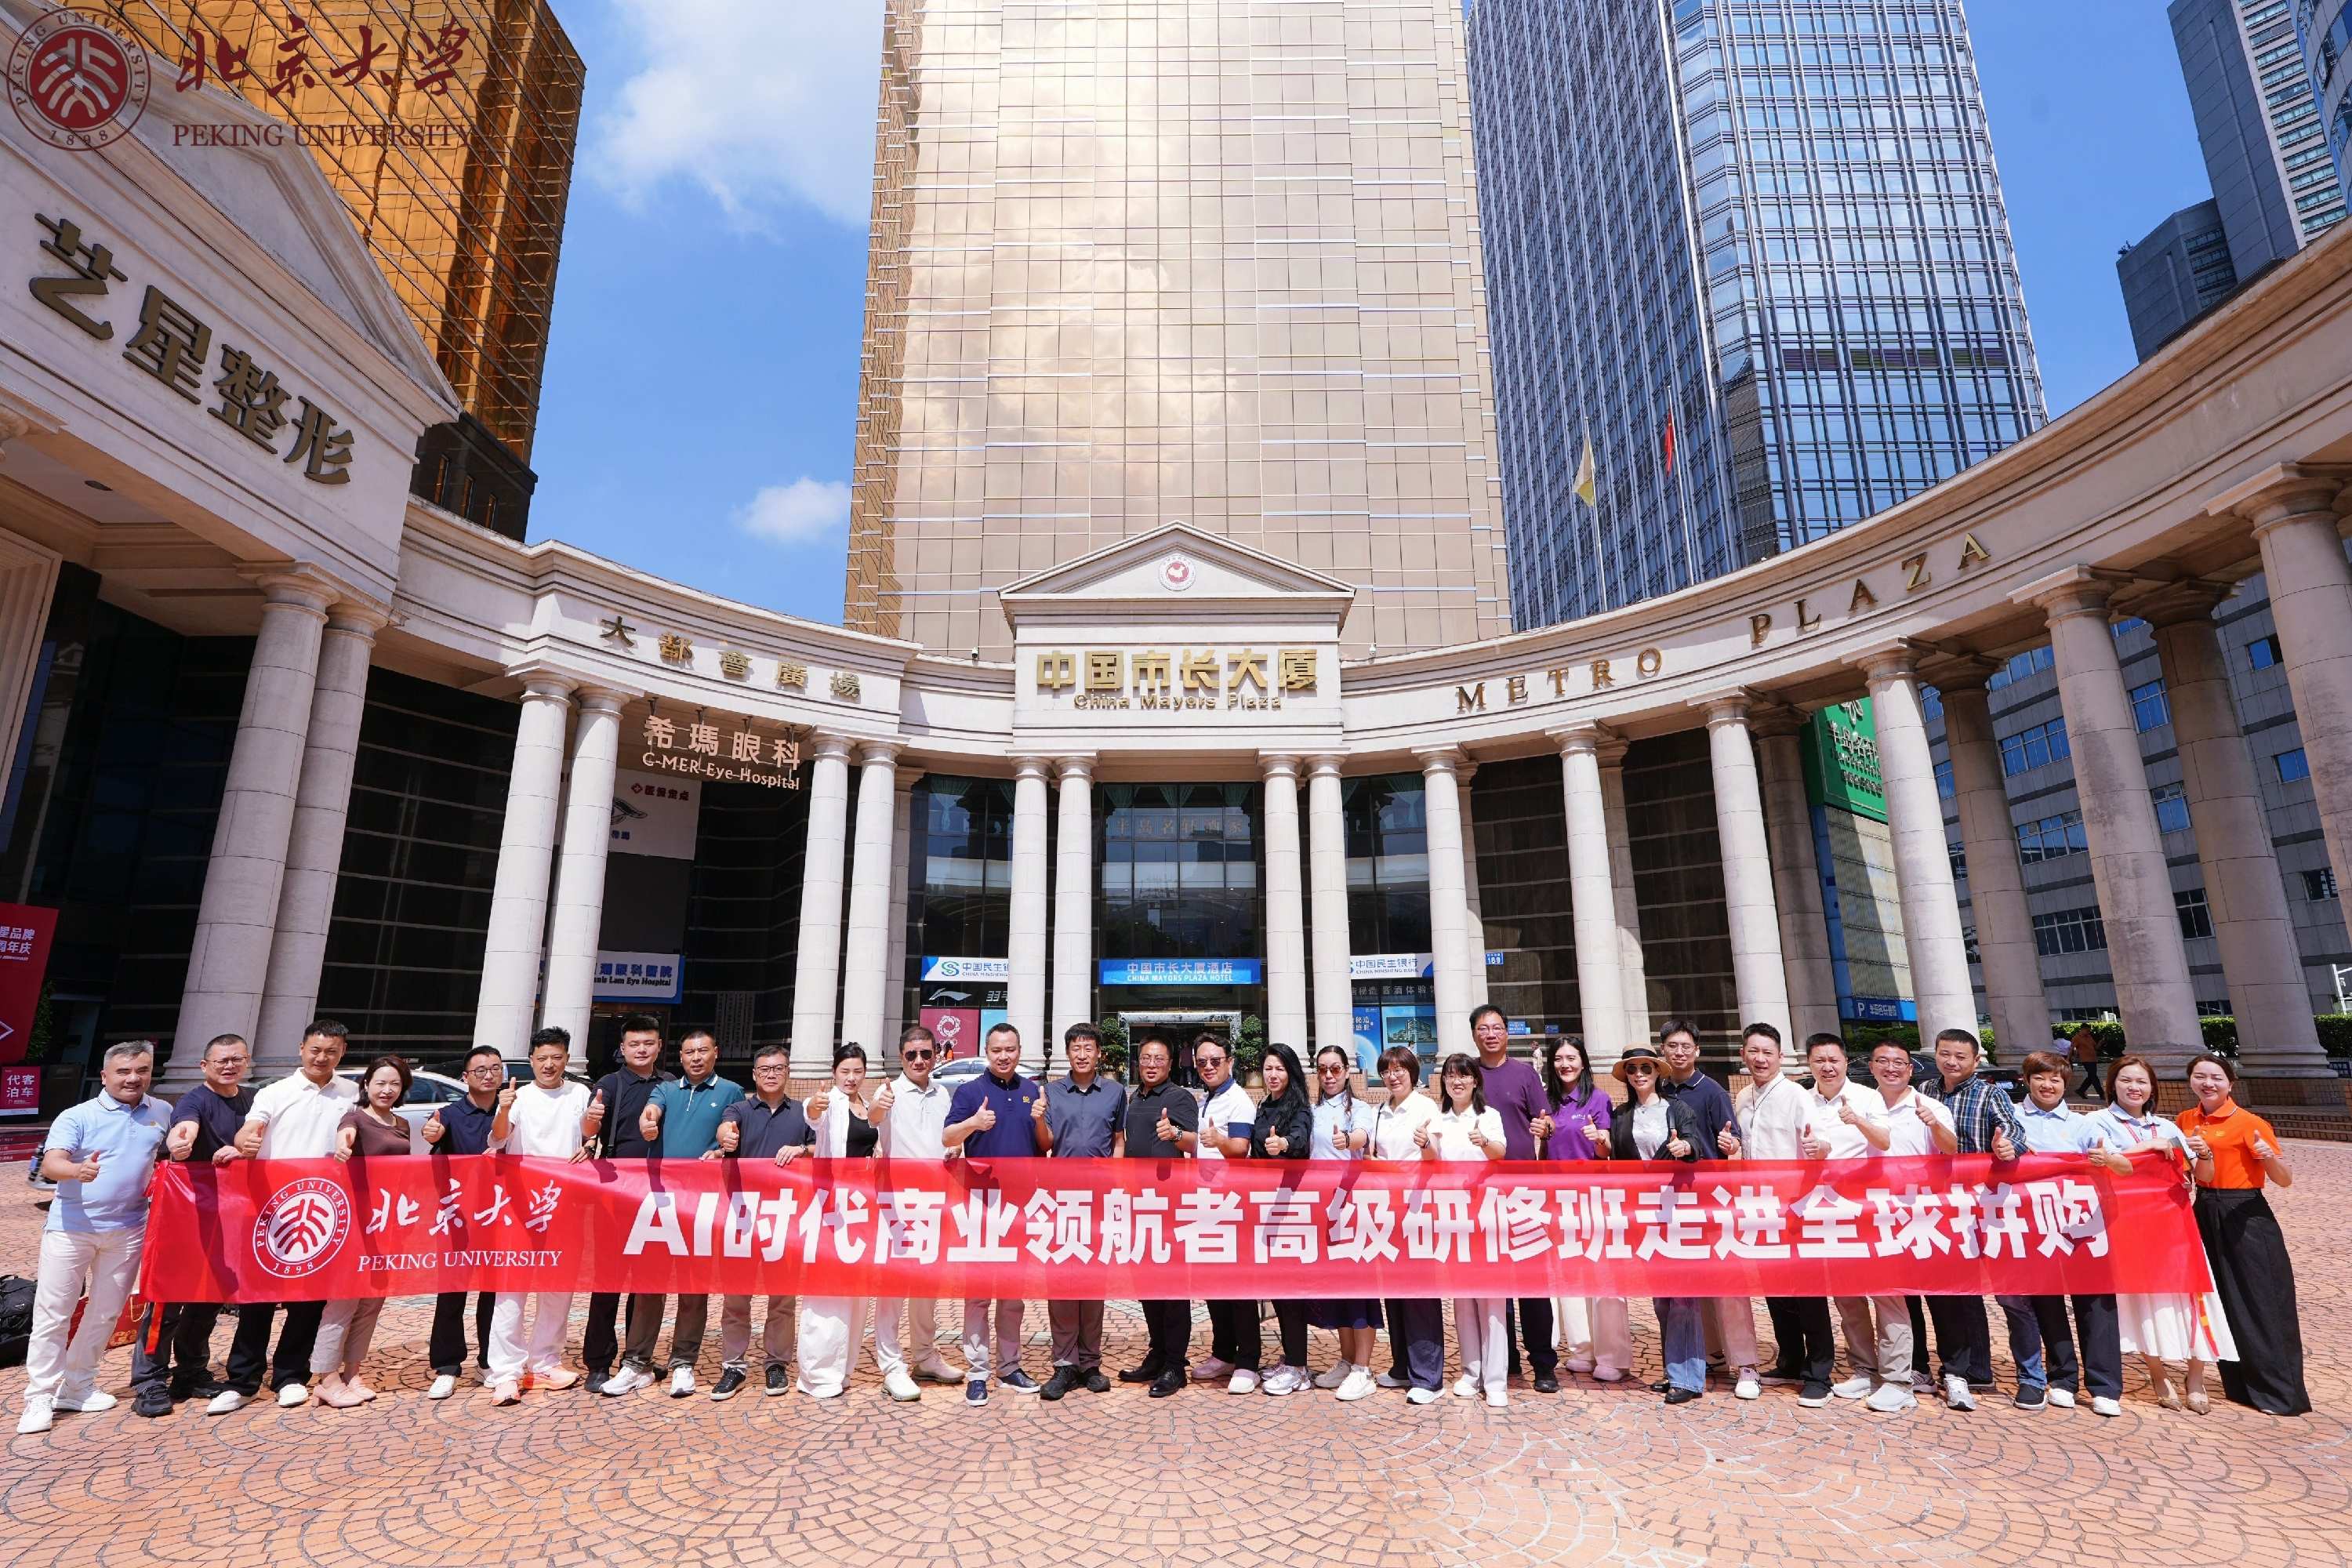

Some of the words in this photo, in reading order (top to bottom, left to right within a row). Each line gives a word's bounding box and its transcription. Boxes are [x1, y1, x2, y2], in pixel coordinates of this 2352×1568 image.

[29, 212, 356, 485] 艺星整形
[1455, 648, 1662, 710] METRO
[1748, 532, 1991, 646] PLAZA
[1036, 648, 1318, 690] 中国市长大厦
[1073, 692, 1129, 710] China
[1139, 692, 1217, 712] Mayors
[1227, 691, 1282, 710] Plaza
[642, 752, 700, 774] C-MER
[706, 762, 733, 780] Eye
[739, 768, 800, 790] Hospital
[1127, 962, 1233, 975] 中国市长大厦酒店
[1356, 958, 1418, 968] 中国民生银行
[626, 977, 641, 987] Eye
[641, 977, 671, 987] Hospital
[1857, 1002, 1865, 1017] P
[6, 1074, 35, 1085] 代客
[6, 1087, 34, 1098] 泊车
[256, 1192, 289, 1248] PEKING
[296, 1181, 347, 1246] UNIVERSITY
[623, 1179, 2110, 1265] AI时代商业领航者高级研修班走进全球拼购
[272, 1261, 314, 1274] 1898
[357, 1252, 437, 1272] PEKING
[443, 1250, 563, 1267] UNIVERSITY
